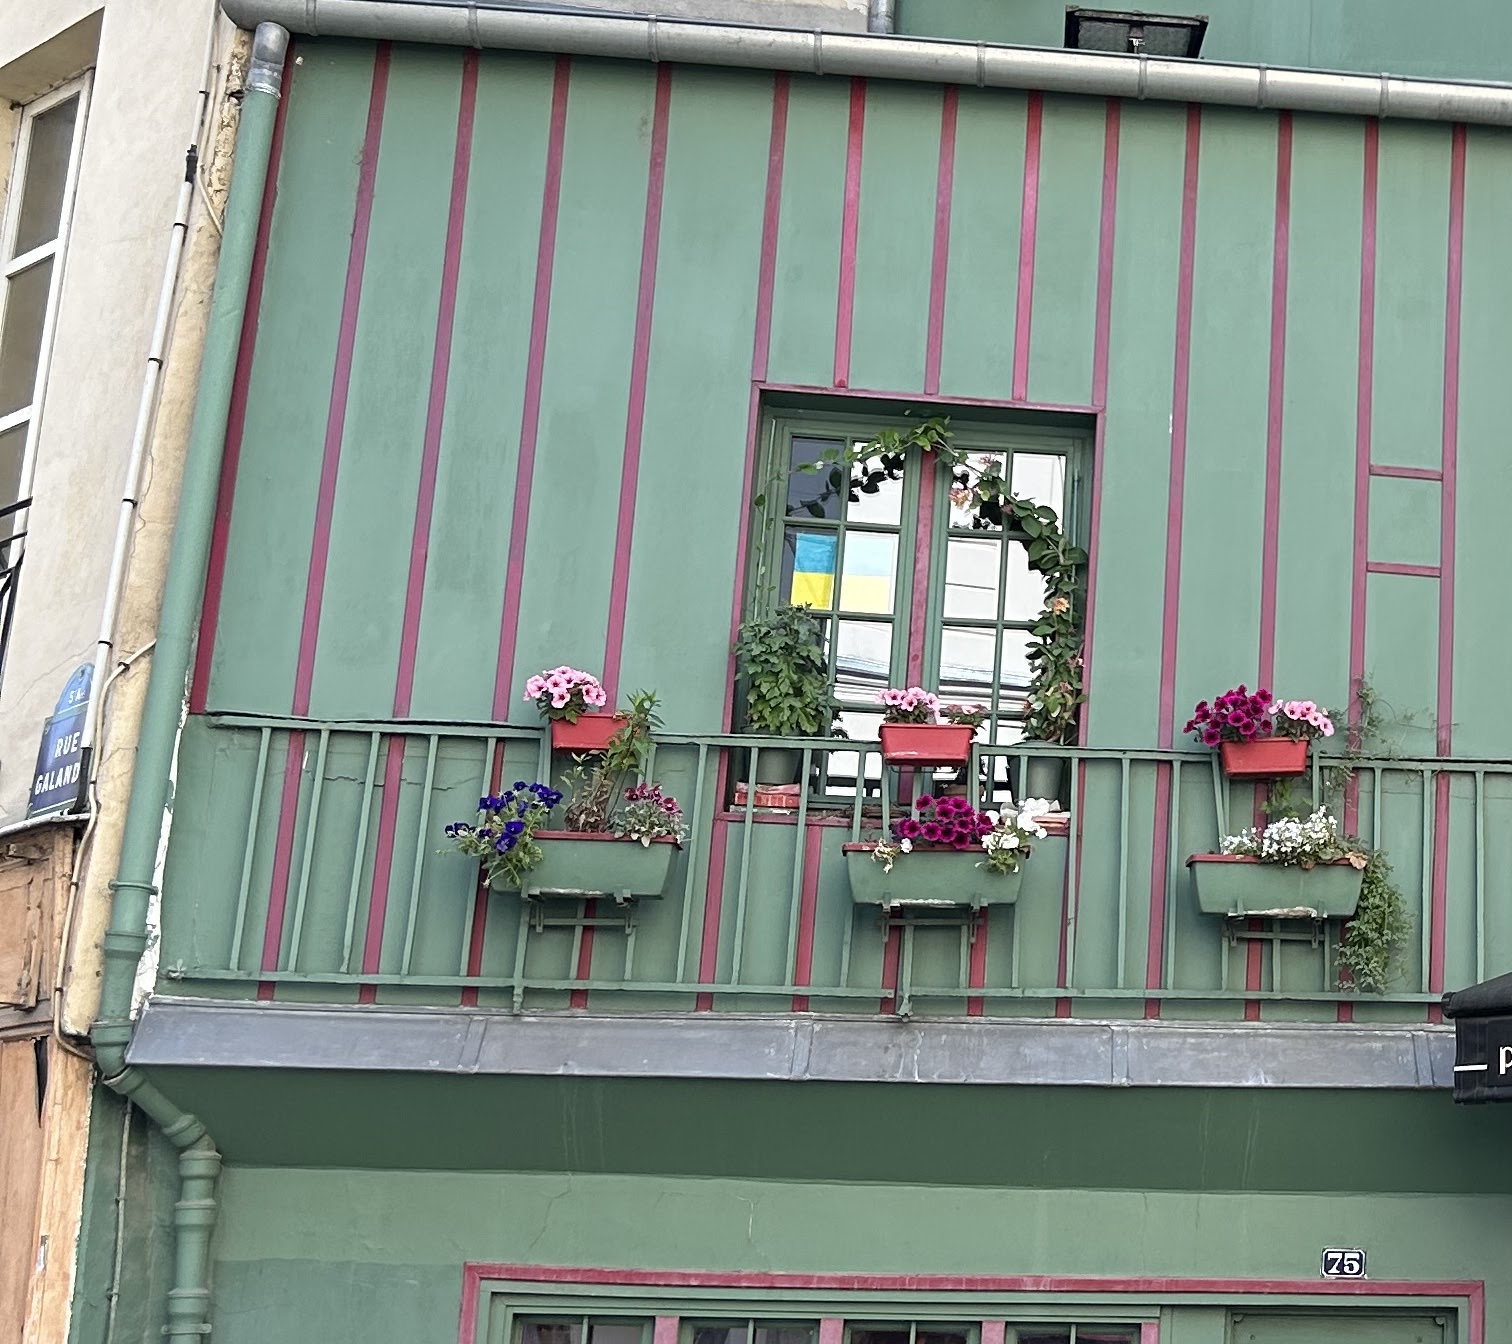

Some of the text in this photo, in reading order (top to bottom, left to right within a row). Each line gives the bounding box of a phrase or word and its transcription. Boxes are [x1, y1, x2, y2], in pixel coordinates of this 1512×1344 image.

[55, 732, 81, 758] RUE
[35, 762, 80, 796] GALAND
[1327, 1252, 1361, 1274] 75
